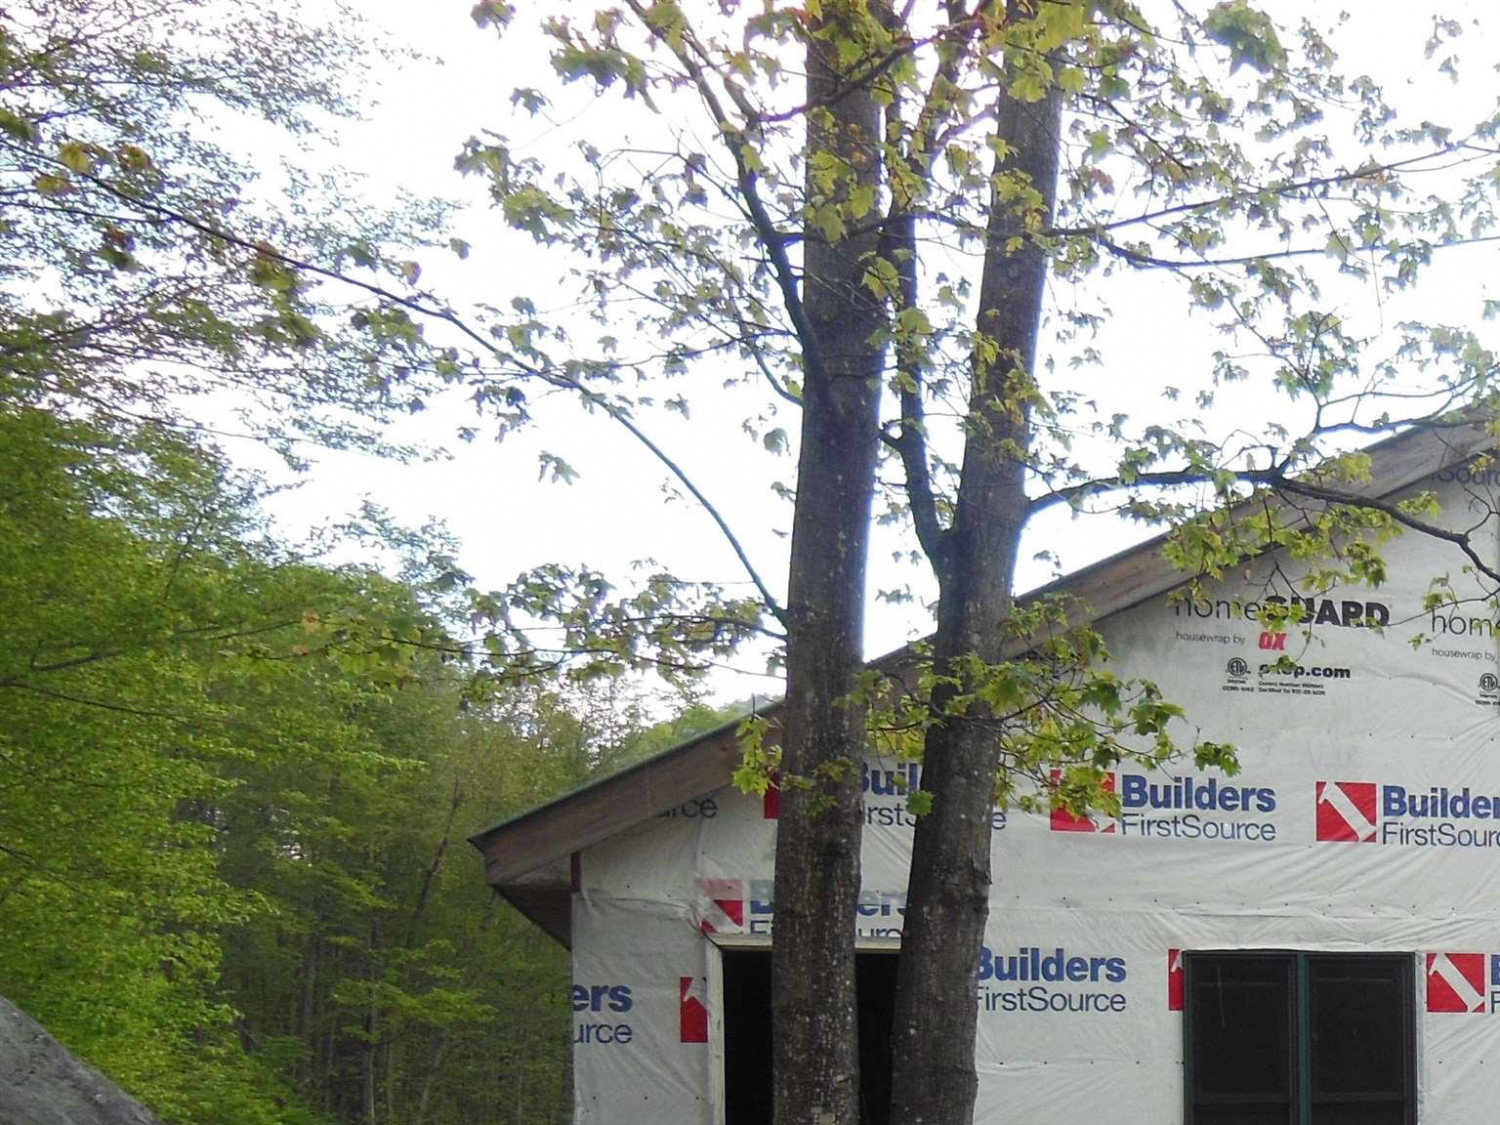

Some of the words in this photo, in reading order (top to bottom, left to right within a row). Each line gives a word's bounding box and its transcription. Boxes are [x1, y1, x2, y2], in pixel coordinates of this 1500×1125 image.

[1232, 635, 1246, 647] by
[1258, 631, 1287, 651] OX
[1484, 652, 1495, 661] by
[1122, 775, 1276, 813] Builders
[1121, 813, 1276, 841] FirstSource
[977, 947, 1126, 983] Builders
